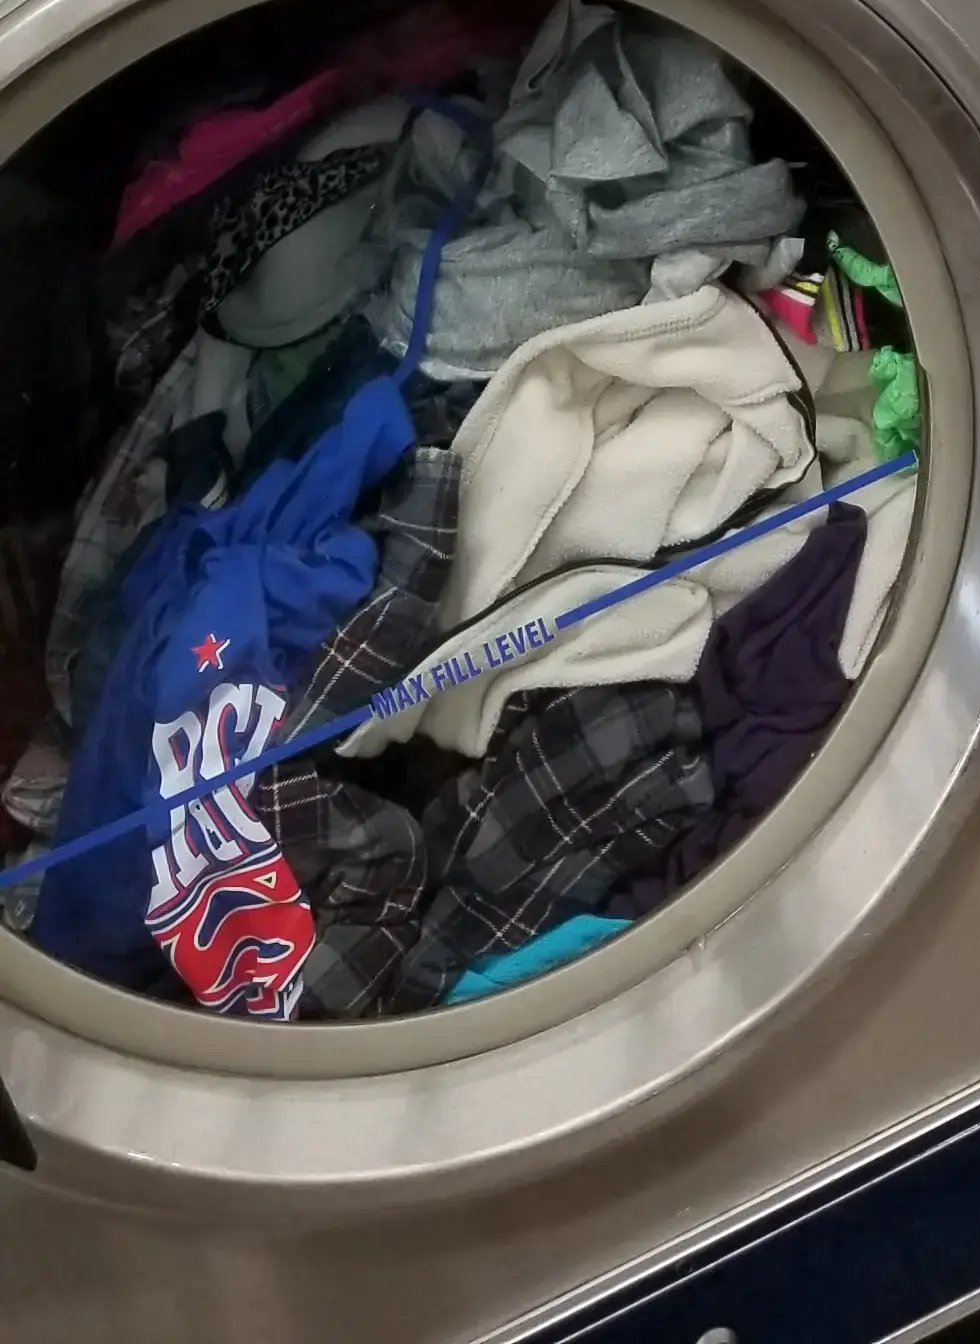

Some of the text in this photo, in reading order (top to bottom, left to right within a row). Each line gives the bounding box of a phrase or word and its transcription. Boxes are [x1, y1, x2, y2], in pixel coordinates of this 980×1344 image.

[370, 617, 555, 720] MAX FILL LEVEL
